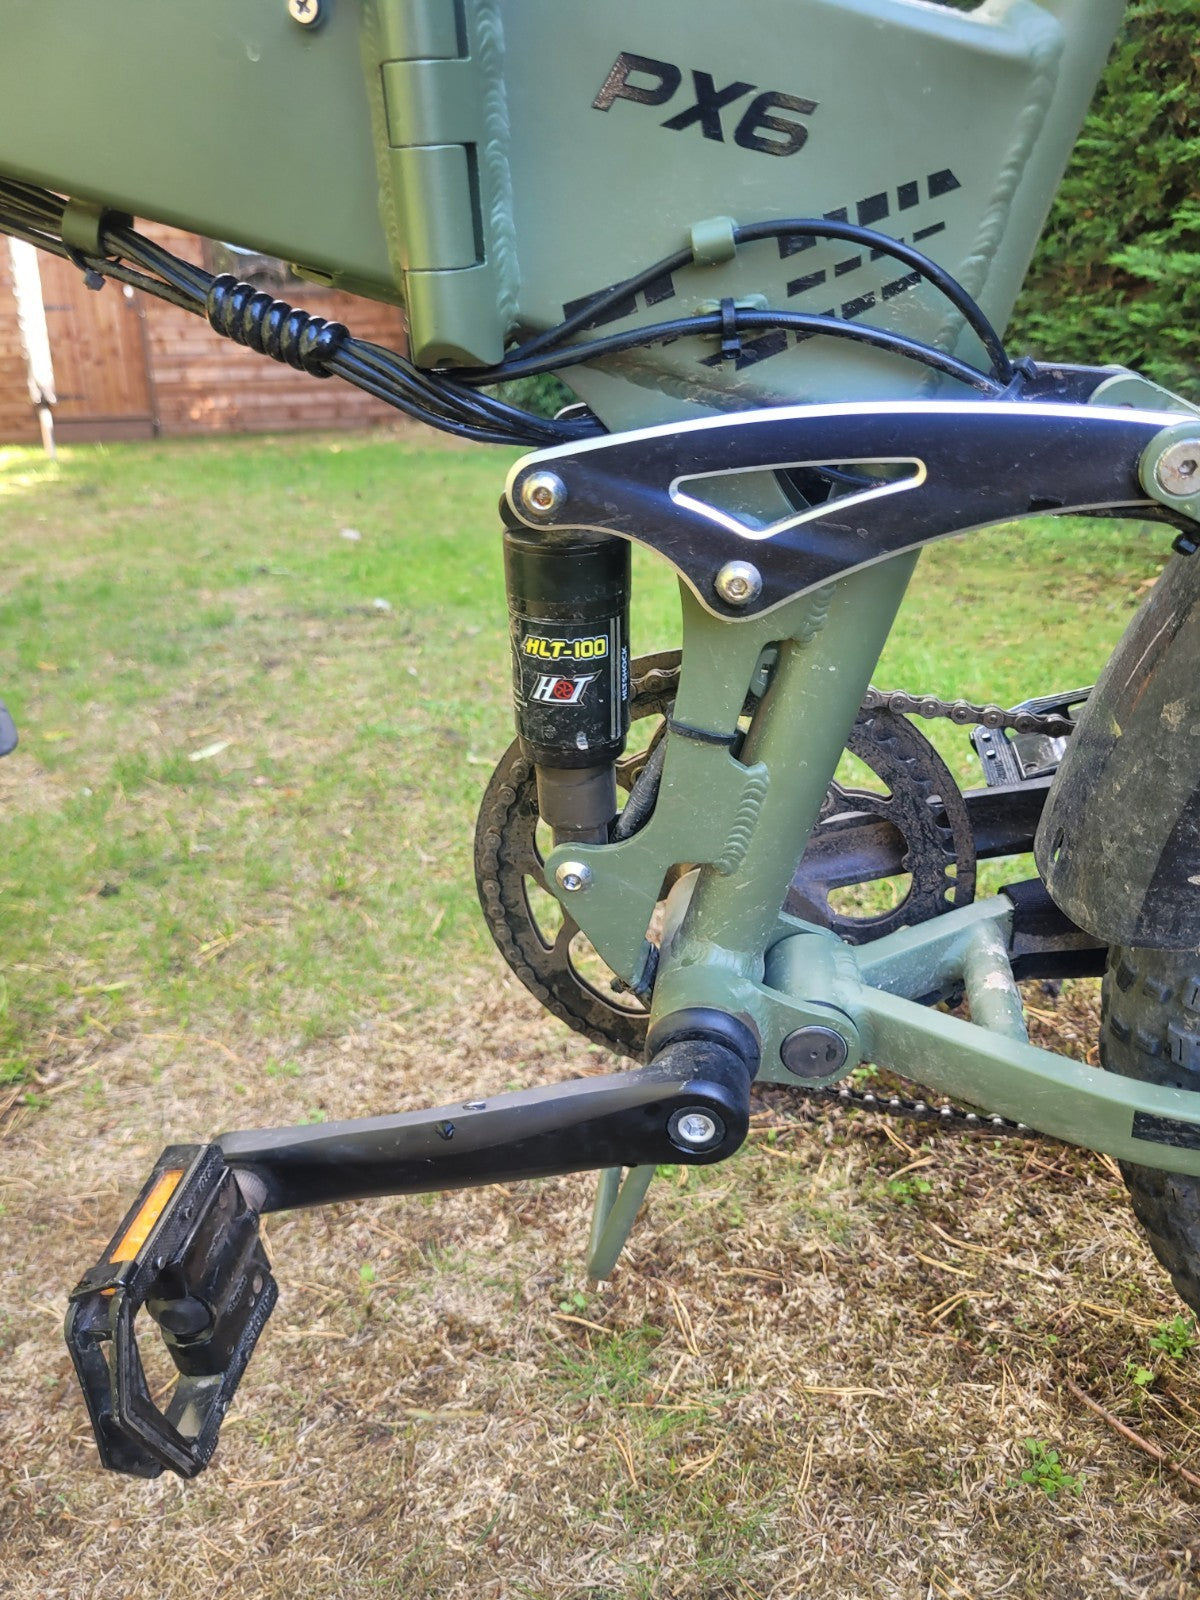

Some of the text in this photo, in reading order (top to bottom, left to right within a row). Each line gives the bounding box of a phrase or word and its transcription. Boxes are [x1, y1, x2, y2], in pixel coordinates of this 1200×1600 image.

[591, 52, 821, 157] PX6
[525, 637, 606, 658] HLT-100
[532, 675, 596, 703] HOT
